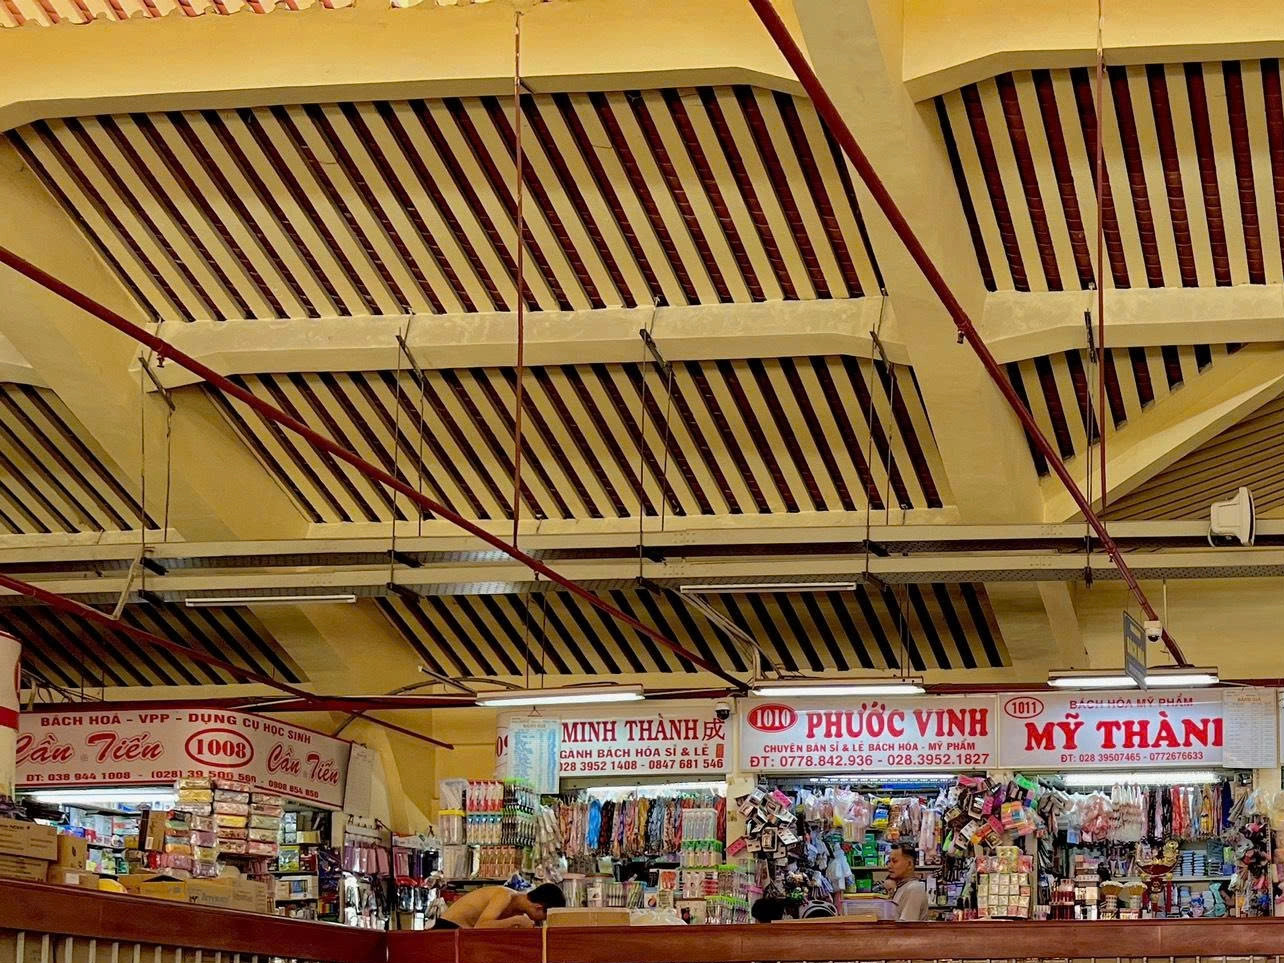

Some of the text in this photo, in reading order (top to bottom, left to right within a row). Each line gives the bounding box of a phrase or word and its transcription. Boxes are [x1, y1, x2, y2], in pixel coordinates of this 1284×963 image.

[1012, 701, 1037, 715] 1011
[1069, 695, 1155, 710] BÁCH MỸ
[756, 709, 791, 727] 1010
[806, 701, 989, 739] PHƯỚC VINH
[41, 713, 311, 744] BÁCH VPP DỤNG CỤ HỌC SINH
[562, 713, 699, 743] MINH THÀNH
[702, 718, 725, 741] 成
[1024, 713, 1085, 751] MỸ
[196, 739, 247, 759] 1008
[597, 745, 661, 758] BÁCH HÓA
[763, 738, 975, 753] CHUYÊN BÁCH HÓA MỸ PHẨM
[268, 744, 300, 774] Cần
[580, 758, 724, 771] 3952 1408 0847 681 546
[750, 753, 989, 768] ĐT: 0778.842.936 028.3952.1827
[1061, 751, 1203, 763] ĐT: 028 39507465 0772676633
[48, 771, 131, 781] 038 1008
